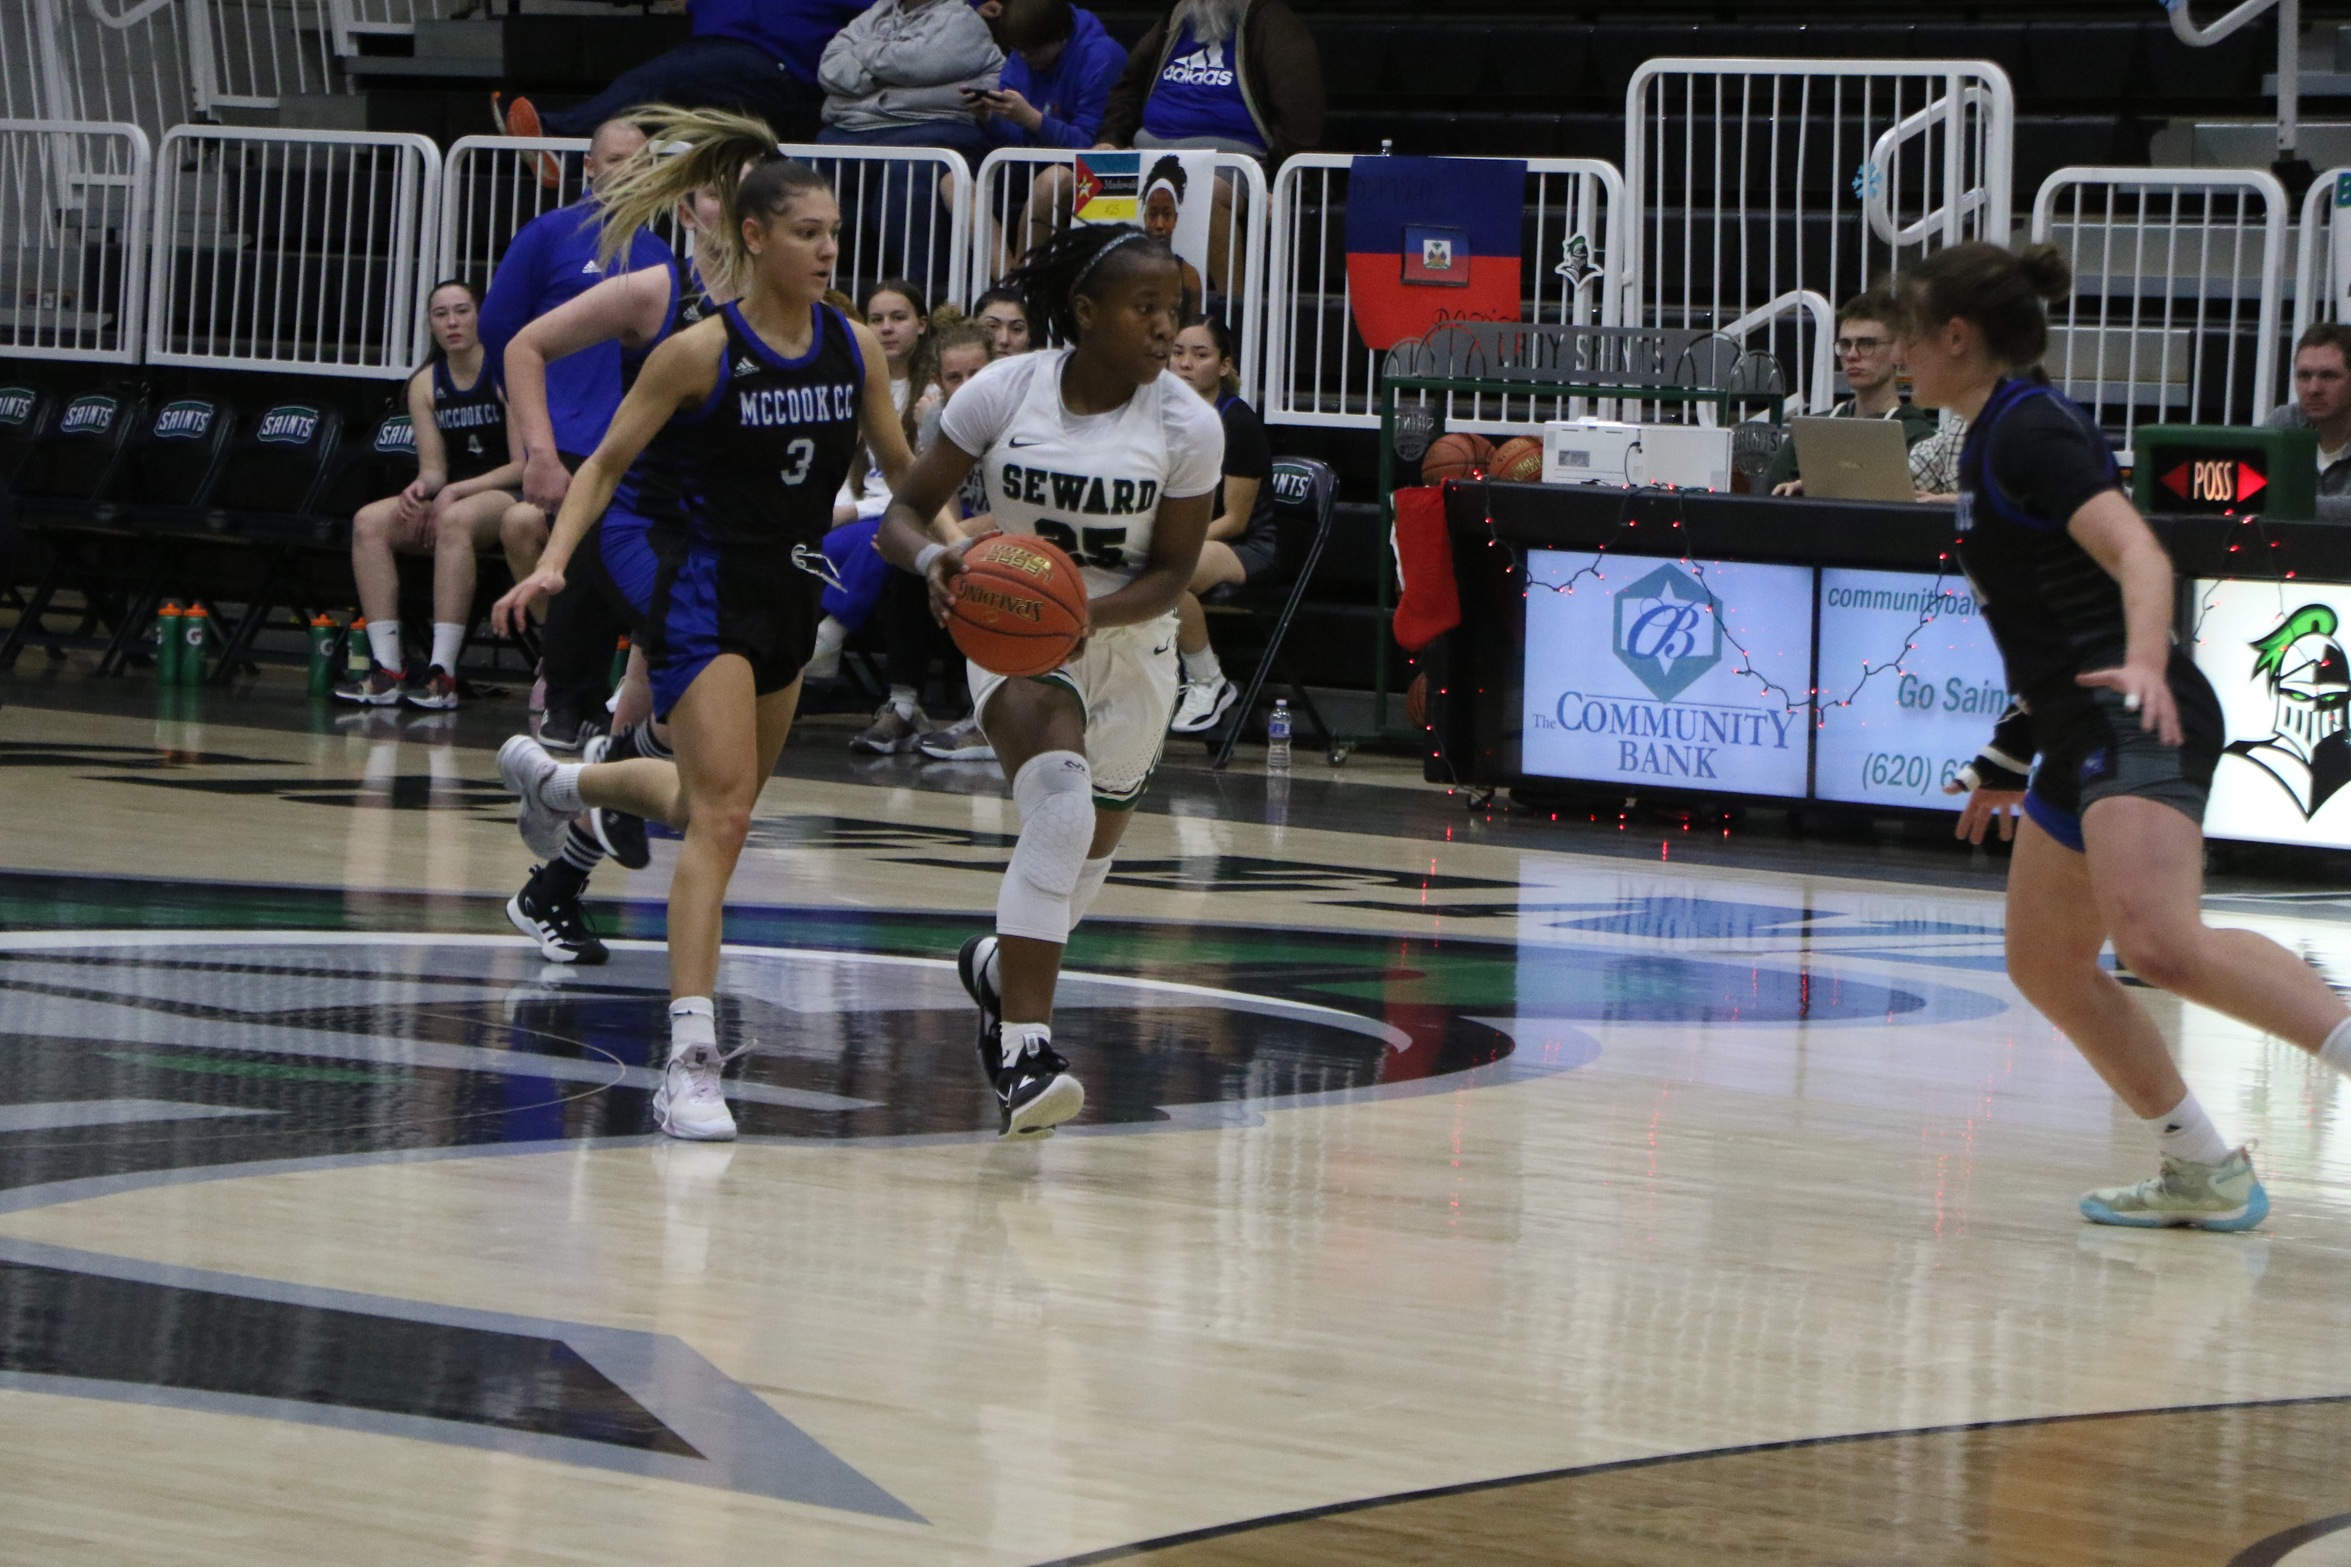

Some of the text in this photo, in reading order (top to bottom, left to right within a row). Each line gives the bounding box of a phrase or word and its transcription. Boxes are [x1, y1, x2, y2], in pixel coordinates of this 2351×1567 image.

[1498, 332, 1665, 374] LADY SAINTS
[0, 396, 31, 418] INTS
[65, 404, 113, 427] SAINTS
[158, 410, 210, 432] SAINTS
[435, 405, 484, 429] MCCOOK
[739, 384, 854, 426] MCCOOK CC
[262, 414, 314, 437] SAINTS
[378, 425, 418, 446] SAIN
[780, 438, 815, 485] 3
[2193, 461, 2233, 501] POSS
[1002, 463, 1158, 515] SEWARD
[1272, 473, 1309, 497] INTS
[958, 581, 1045, 623] SPALDING
[1898, 674, 1935, 710] Go
[1532, 691, 1797, 749] The COMMUNITY
[1617, 740, 1718, 780] BANK
[1862, 752, 1932, 796] (620)
